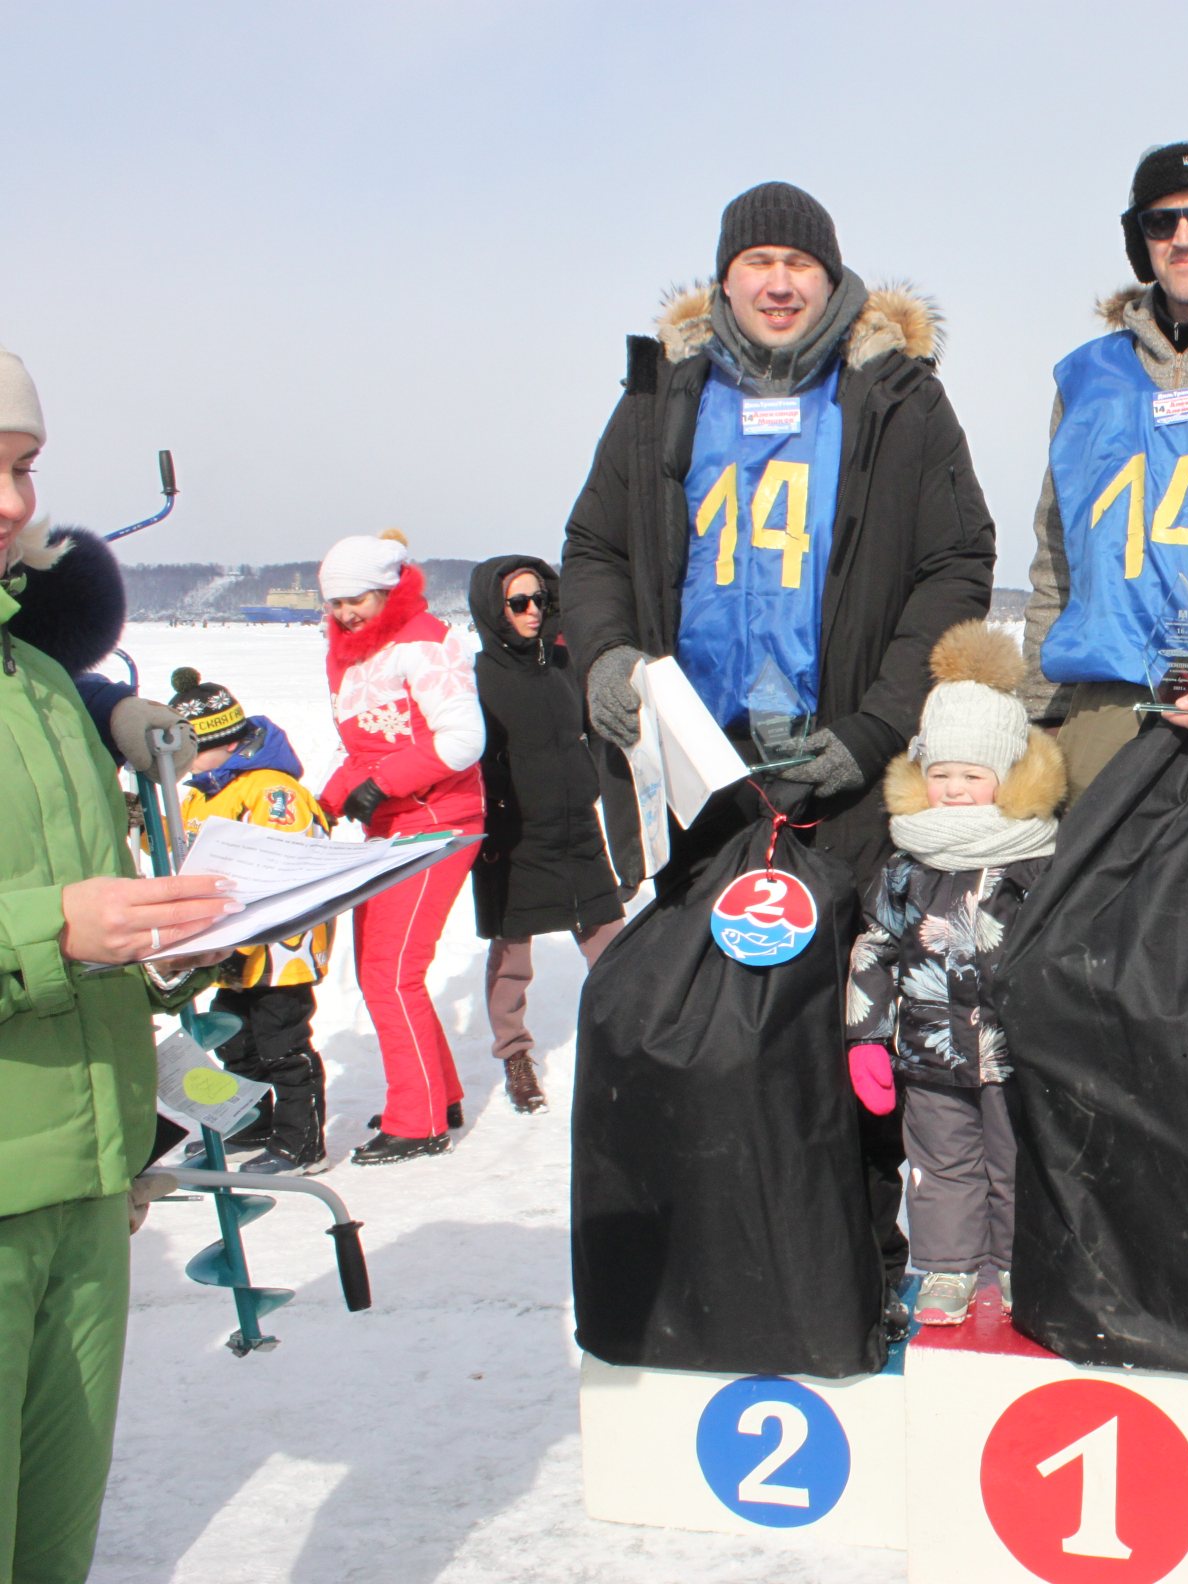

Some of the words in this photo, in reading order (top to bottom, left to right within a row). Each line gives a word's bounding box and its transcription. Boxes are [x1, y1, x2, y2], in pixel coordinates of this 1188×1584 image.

[695, 459, 810, 589] 14
[744, 878, 785, 916] 2
[737, 1400, 810, 1508] 2
[1035, 1415, 1133, 1560] 1
